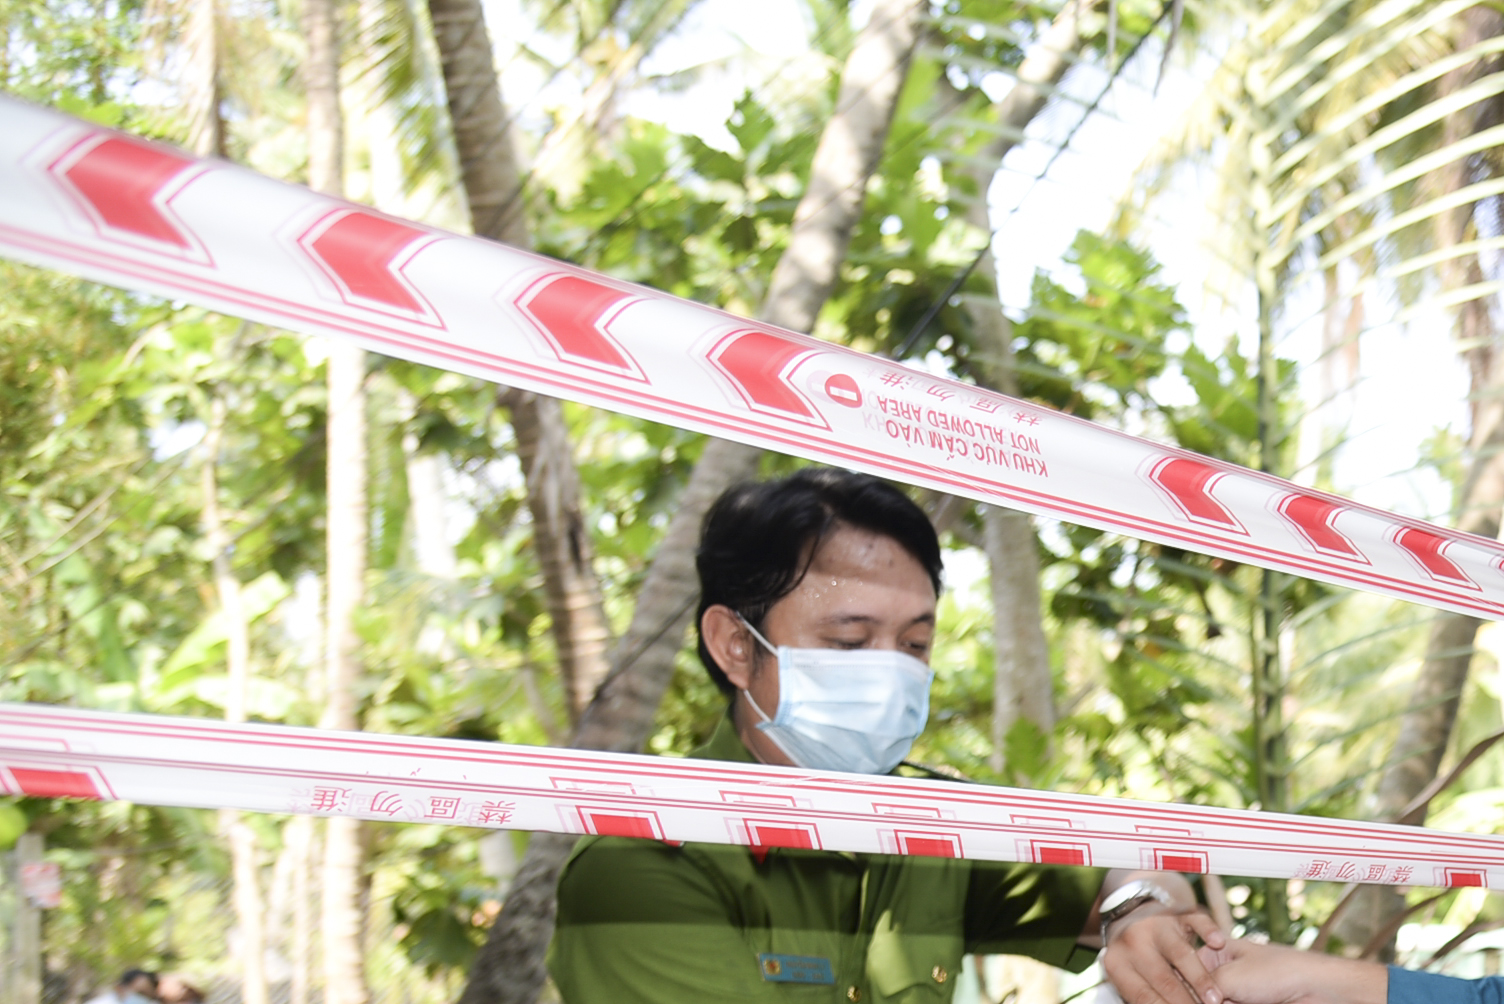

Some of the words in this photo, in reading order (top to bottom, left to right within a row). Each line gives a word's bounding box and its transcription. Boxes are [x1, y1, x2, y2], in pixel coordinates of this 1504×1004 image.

[876, 395, 921, 425] AREA
[885, 419, 925, 448] VÀO
[927, 409, 1004, 445] ALLOWED
[928, 430, 968, 461] CẤM
[972, 443, 1010, 469] VỰC
[1010, 432, 1041, 455] NOT
[1012, 453, 1049, 478] KHU
